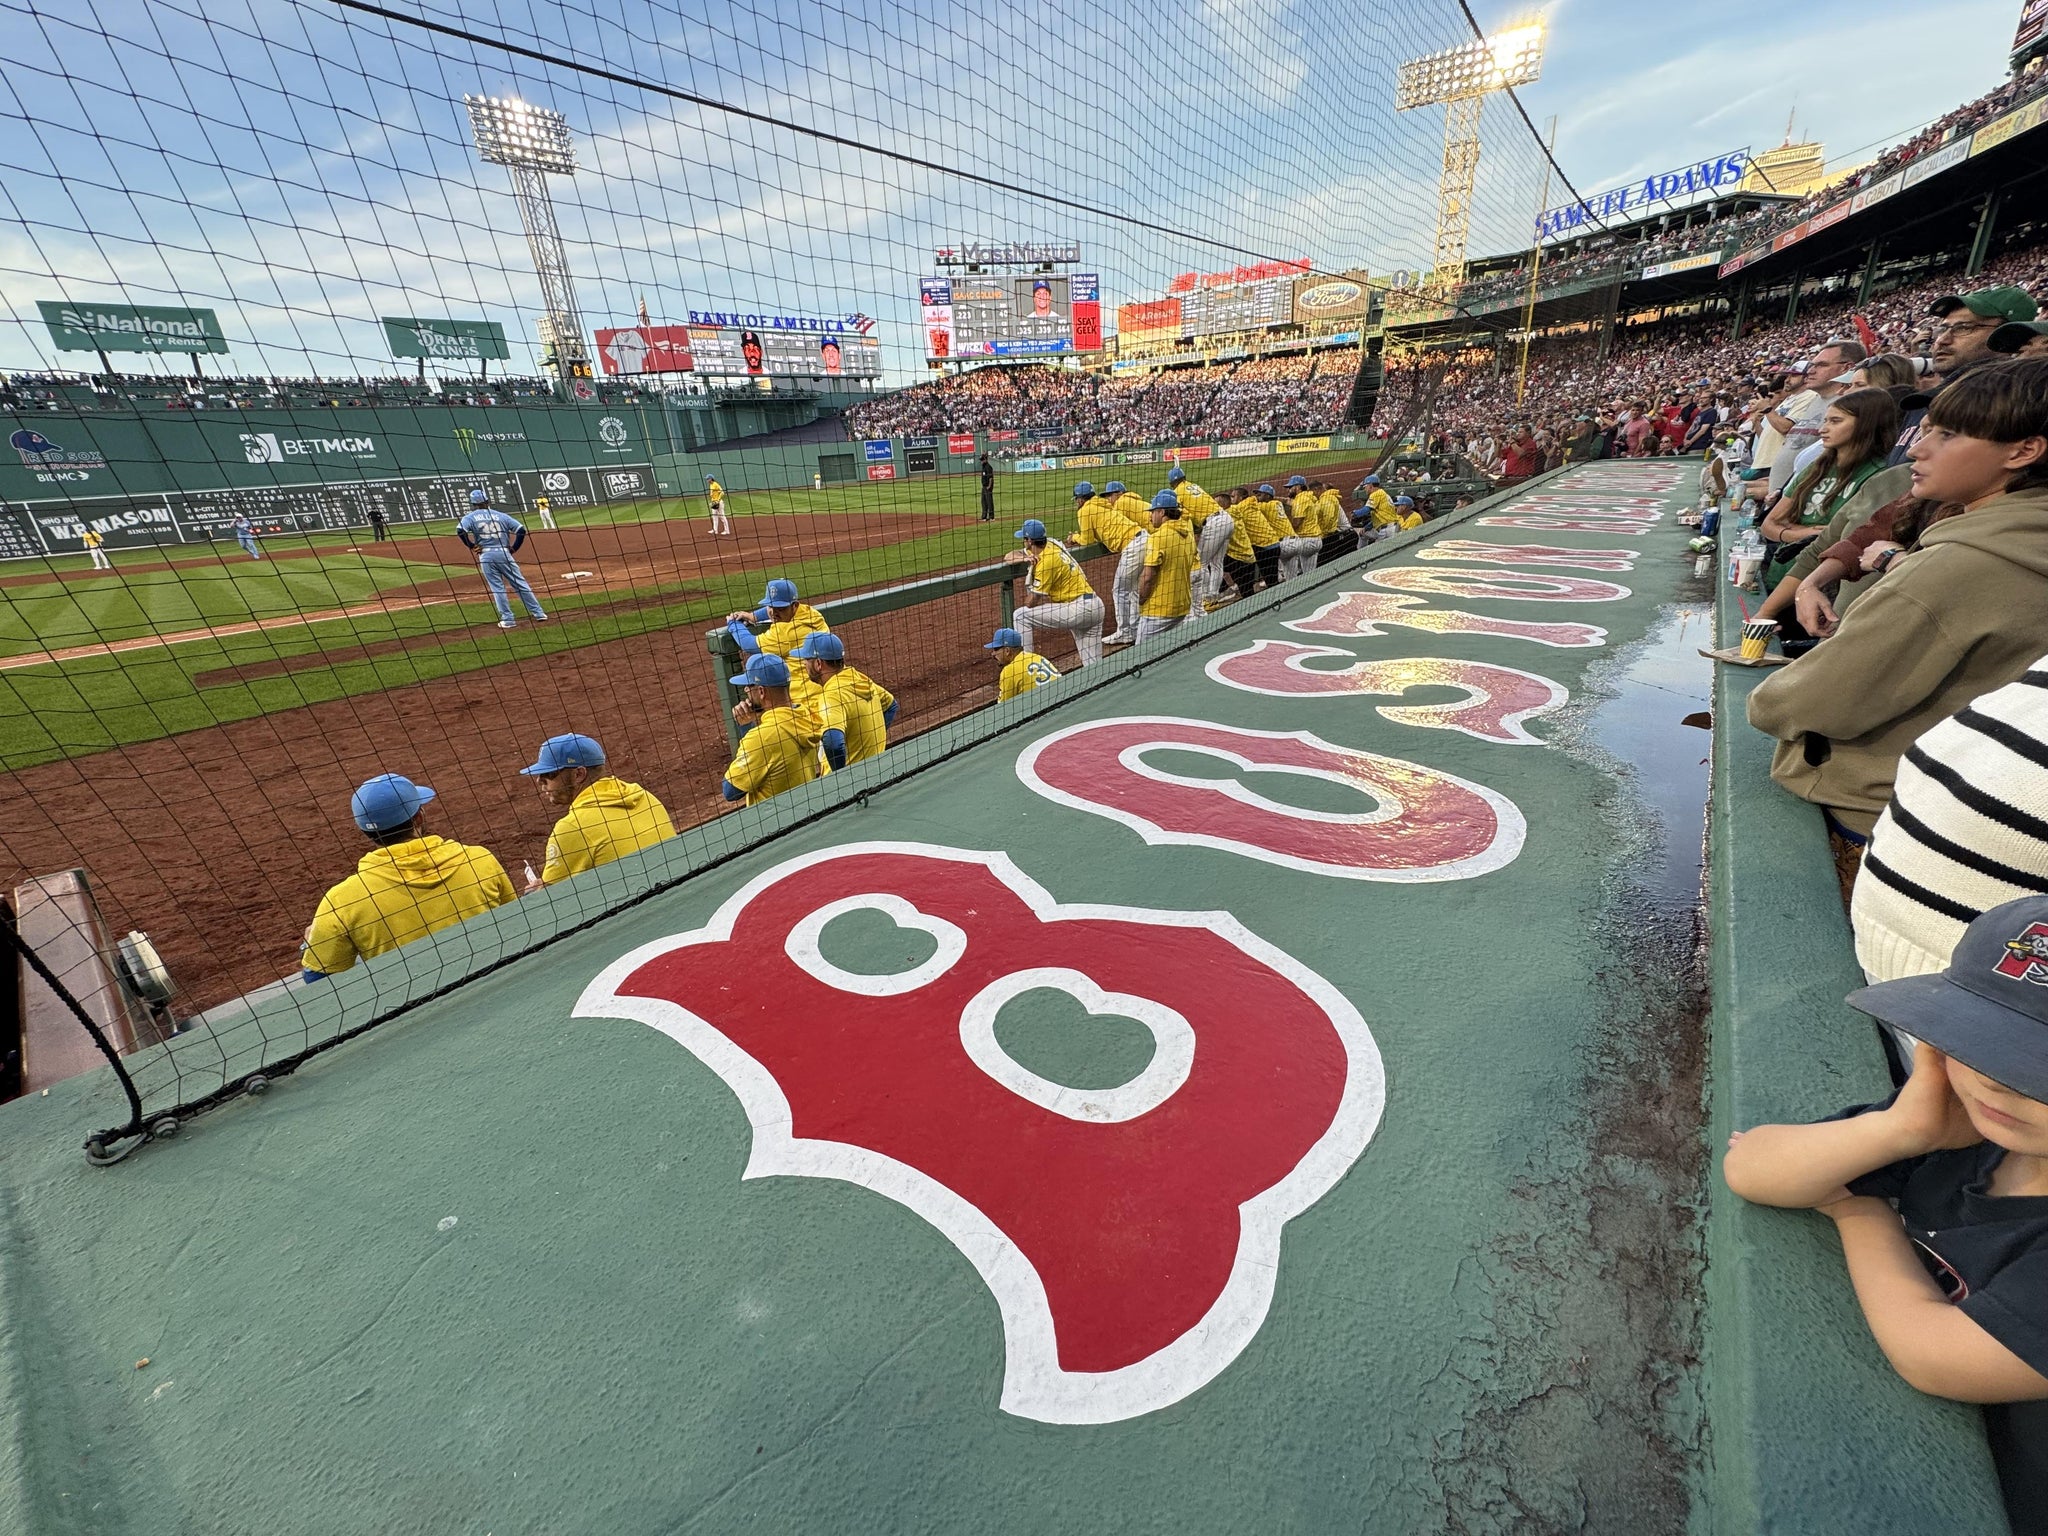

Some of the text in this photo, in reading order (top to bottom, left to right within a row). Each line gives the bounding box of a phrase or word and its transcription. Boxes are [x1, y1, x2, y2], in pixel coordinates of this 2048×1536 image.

[1534, 152, 1745, 242] SAMUEL ADAMS
[961, 241, 1080, 263] MassMutual
[976, 291, 1003, 300] COLLINS
[1311, 286, 1349, 306] Ford
[97, 313, 206, 338] National
[689, 310, 845, 333] BANK OF AMERICA
[1077, 317, 1097, 326] SEAT
[1077, 326, 1098, 335] GEEK
[143, 336, 207, 349] Car Rental
[418, 333, 476, 349] DRAFT
[429, 344, 480, 357] KINGS
[774, 362, 816, 373] 0 2 2
[477, 432, 526, 442] MONSTER
[282, 437, 375, 456] BETMGM
[1286, 441, 1309, 452] TWISTED
[28, 451, 104, 463] RED SOX
[1126, 450, 1153, 461] wasabi
[37, 473, 78, 483] BIDMC
[611, 473, 640, 486] ACE
[613, 482, 641, 495] TICKET
[40, 517, 61, 525] WHO
[89, 508, 171, 534] MASON
[196, 512, 220, 520] BOSTON
[265, 519, 280, 527] OUT
[127, 528, 152, 536] SINCE
[572, 538, 1642, 1426] BOSTON
